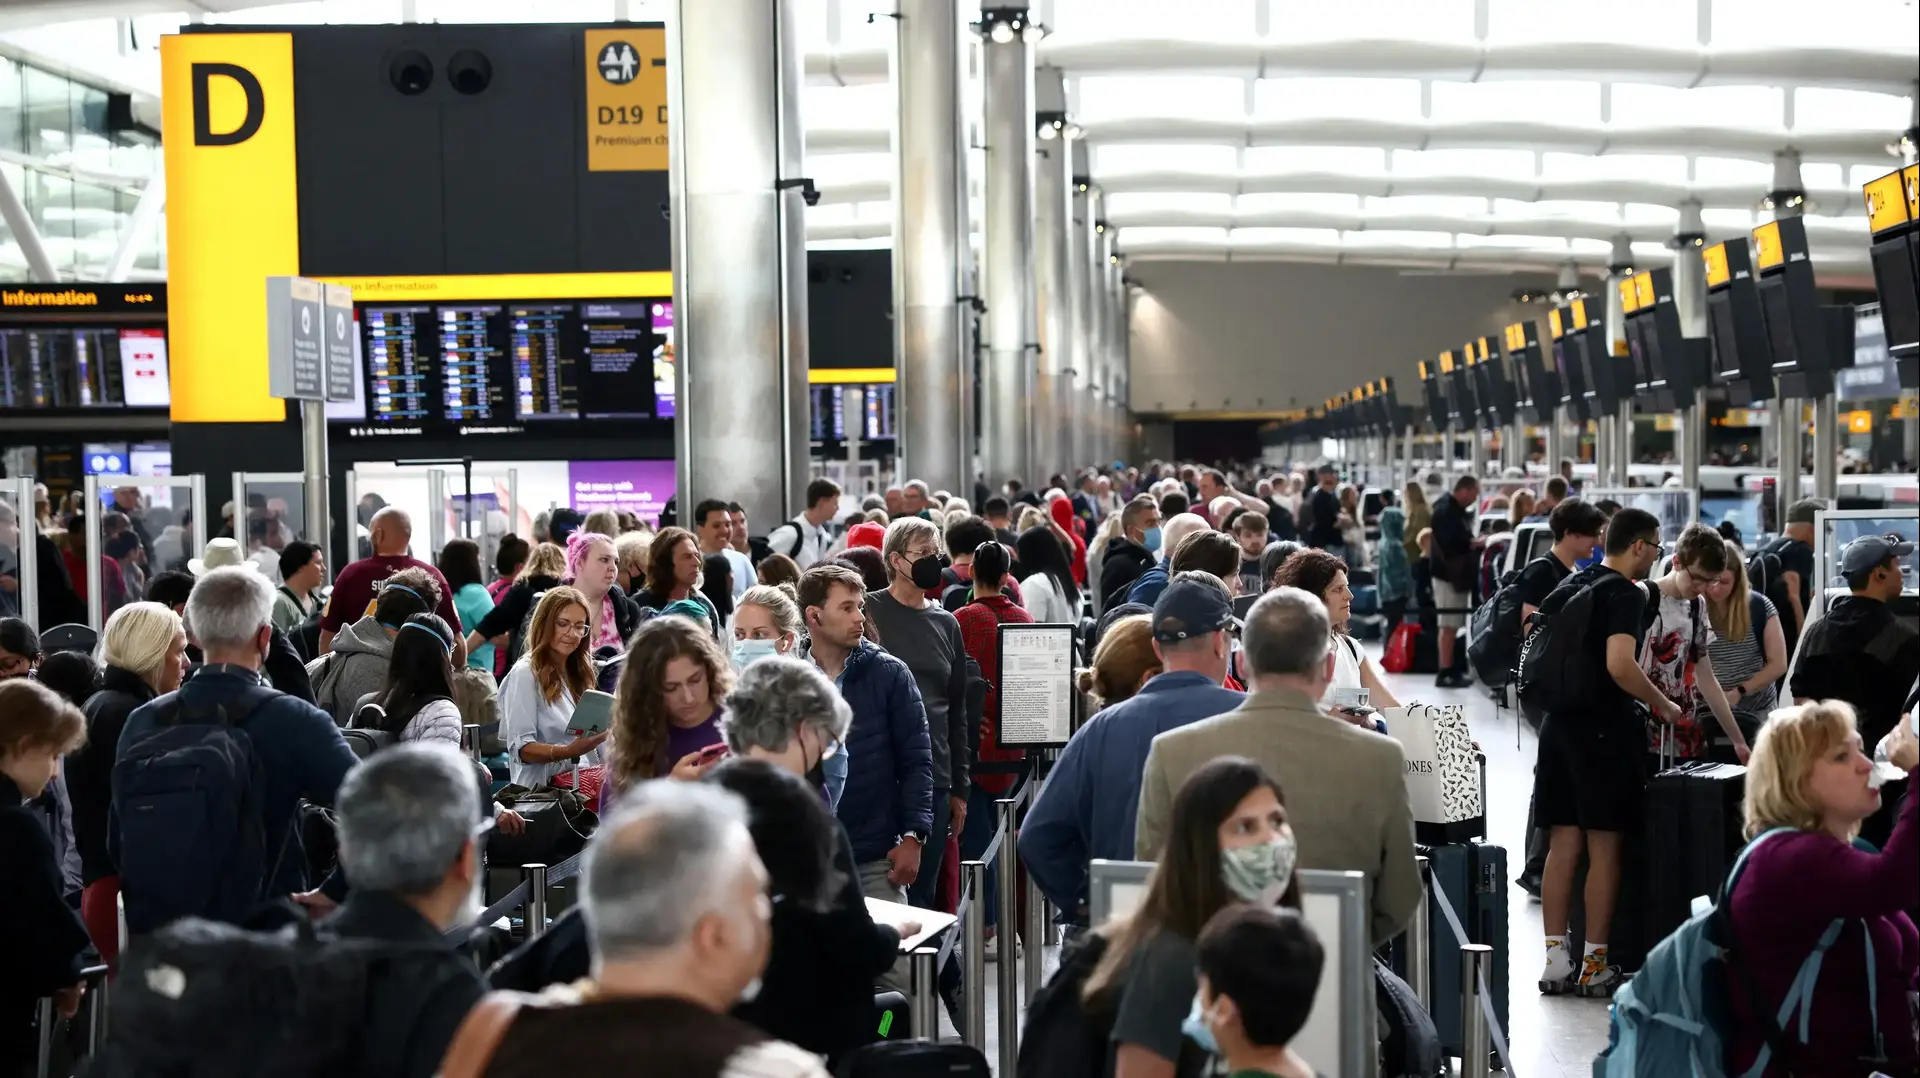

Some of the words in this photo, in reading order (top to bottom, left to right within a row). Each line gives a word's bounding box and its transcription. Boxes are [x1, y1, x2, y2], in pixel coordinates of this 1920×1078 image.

[191, 63, 265, 147] D
[598, 105, 643, 125] D19
[596, 135, 652, 146] Premium
[2, 289, 98, 305] Information
[371, 580, 387, 591] SU
